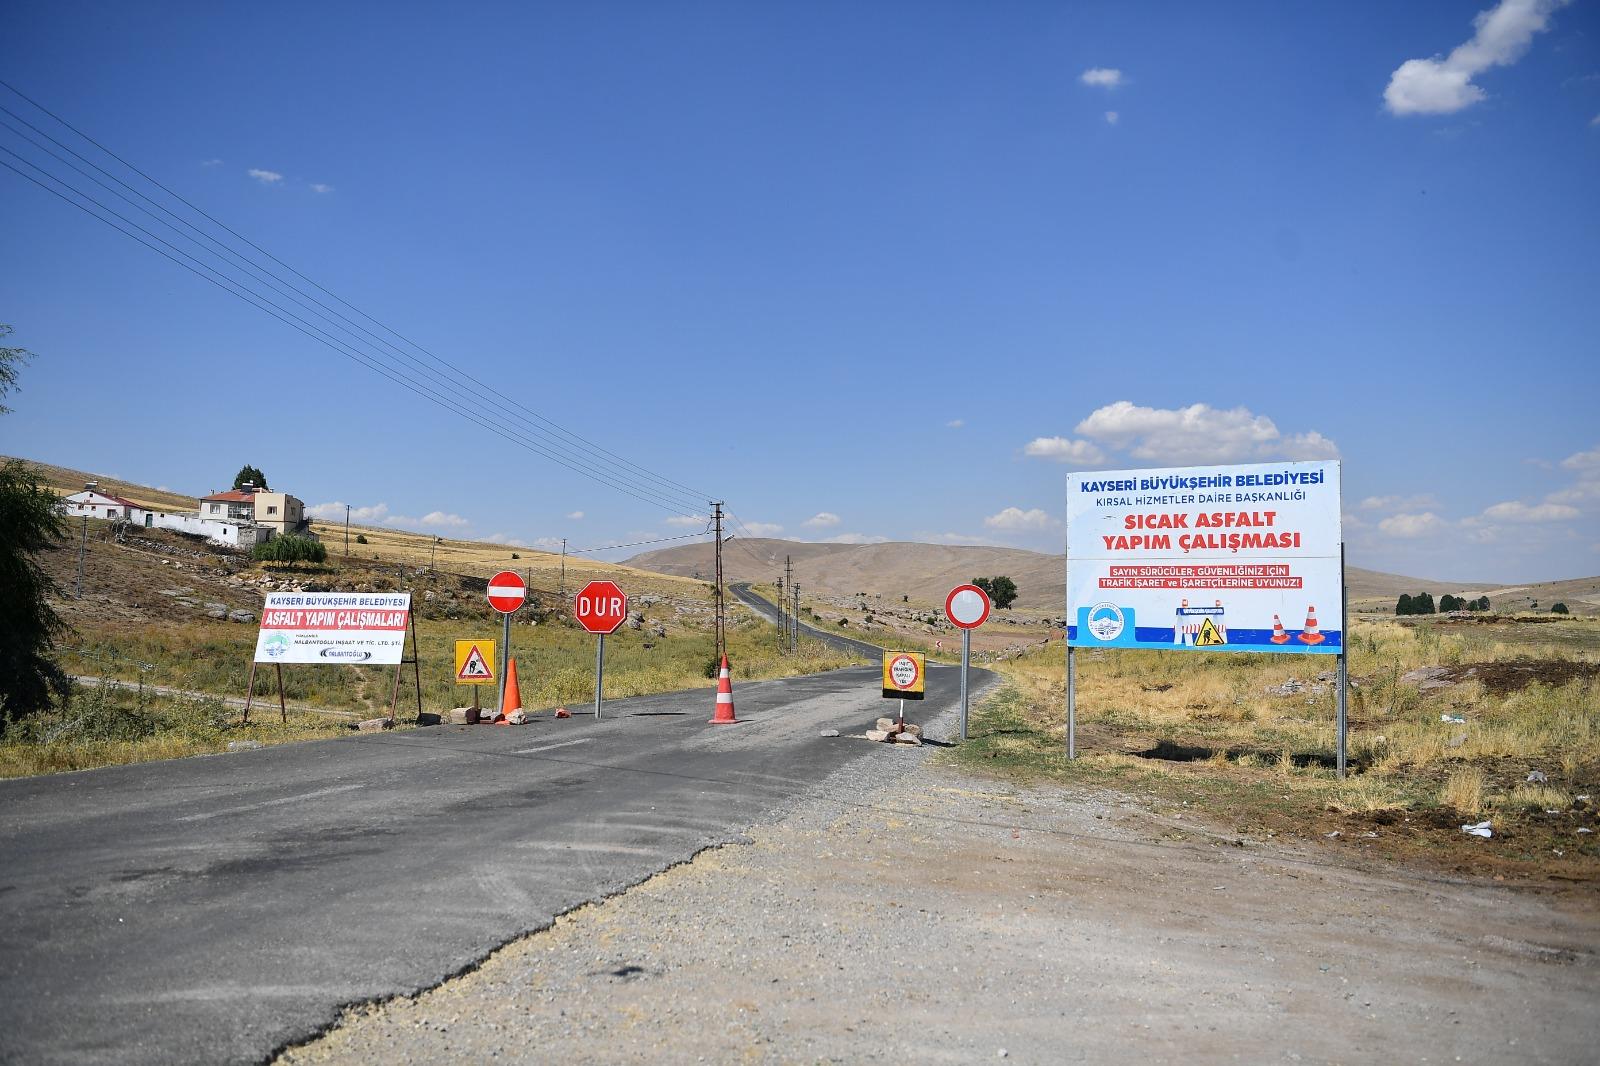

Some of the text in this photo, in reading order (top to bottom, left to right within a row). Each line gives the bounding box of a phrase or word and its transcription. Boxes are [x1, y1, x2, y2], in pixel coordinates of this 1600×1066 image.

[1081, 469, 1324, 493] KAYSERİ BÜYÜKŞEHİR BELEDİYESİ
[1096, 488, 1306, 507] KIRSAL HİZMETLER DAİRE BAŞKANLIĞI
[1124, 511, 1277, 530] SICAK ASFALT
[1102, 532, 1301, 554] YAPIM ÇALIŞMASI
[1112, 565, 1286, 577] SAYIN SÜRÜCÜLER; GÜVENLİĞİNİZ İÇİN
[1101, 578, 1133, 588] TRAFİK
[1134, 577, 1166, 588] İŞARET
[1180, 576, 1254, 588] İŞARETÇİLERİNE
[1256, 578, 1300, 587] UYUNUZ!
[270, 595, 406, 607] KAYSERİ BÜYÜKŞEHİR BELEDİYESİ
[580, 596, 621, 617] DUR
[265, 611, 405, 630] ASFALT YAPIM ÇALIŞMALARI
